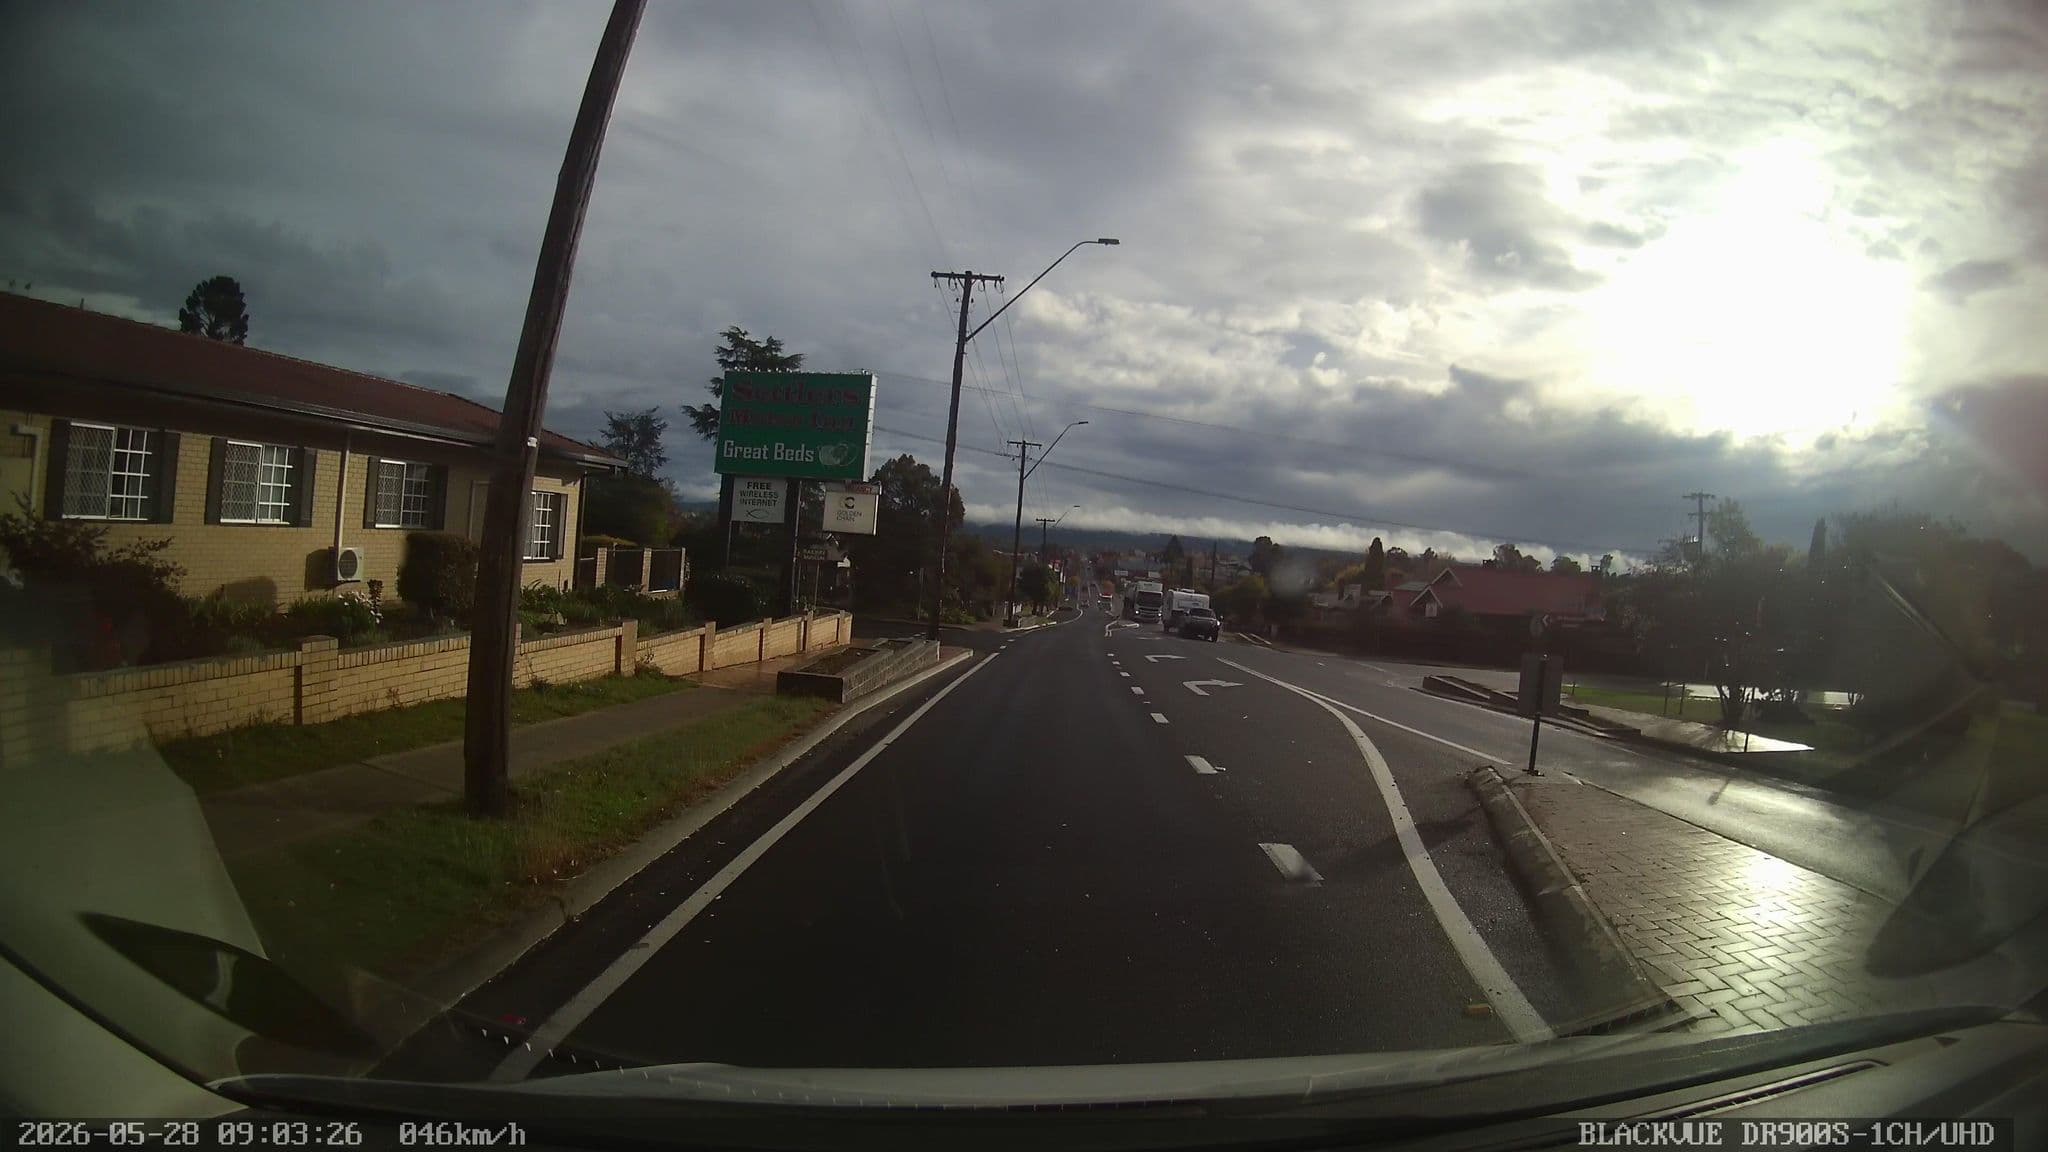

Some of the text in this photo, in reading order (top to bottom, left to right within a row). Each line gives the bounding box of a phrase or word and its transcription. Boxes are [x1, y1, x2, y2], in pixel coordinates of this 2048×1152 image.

[723, 440, 814, 462] Great Beds
[747, 481, 772, 490] FREE
[740, 489, 779, 499] WIRELESS
[740, 498, 778, 508] INTERNET
